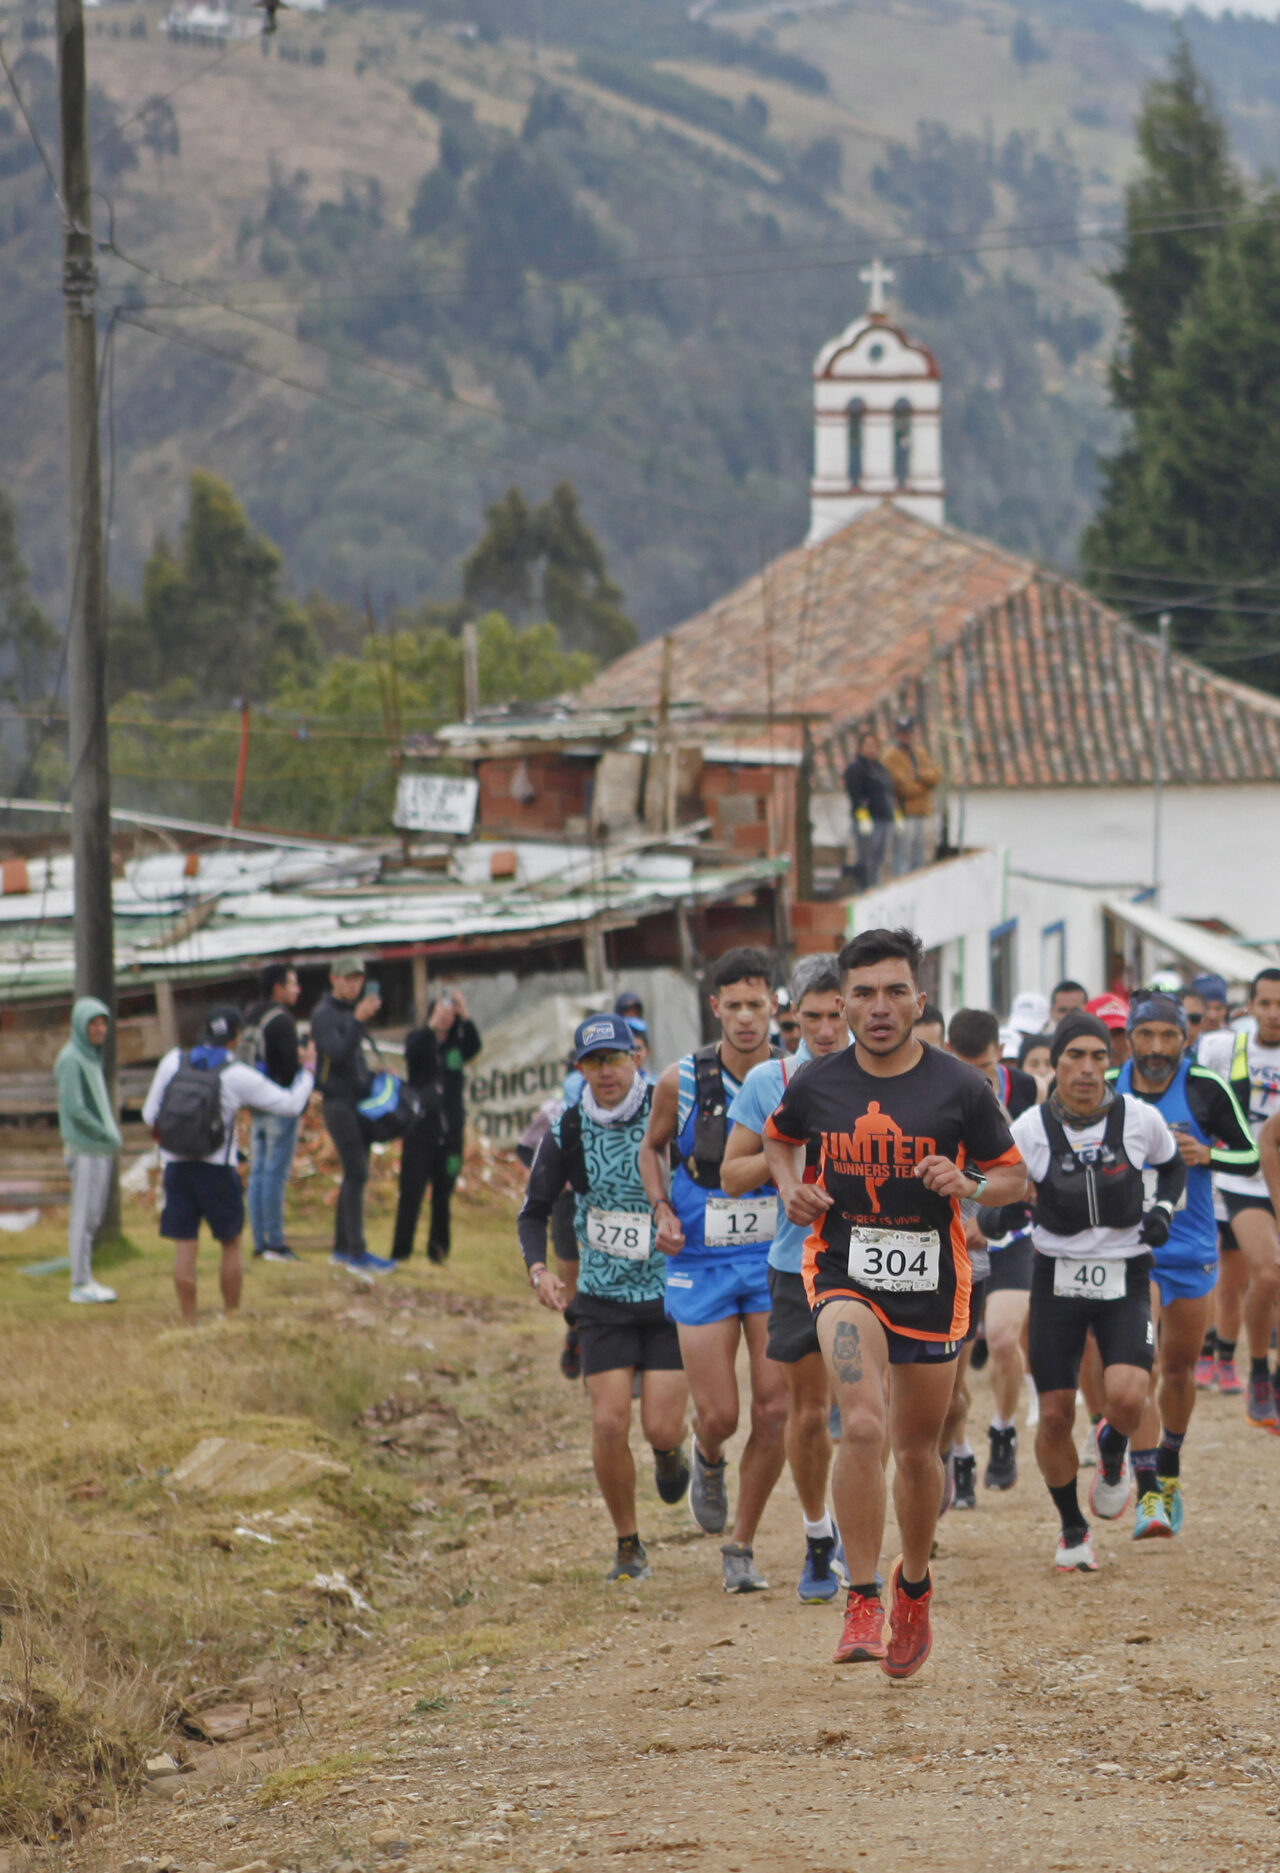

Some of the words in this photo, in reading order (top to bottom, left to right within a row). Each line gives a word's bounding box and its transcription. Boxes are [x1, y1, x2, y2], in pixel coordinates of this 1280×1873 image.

[820, 1131, 937, 1165] UNITED
[833, 1160, 890, 1178] RUNNERS
[893, 1165, 917, 1179] TEA
[727, 1213, 758, 1234] 12
[894, 1215, 921, 1225] VIVIR
[595, 1223, 639, 1248] 278
[863, 1247, 928, 1277] 304
[1073, 1264, 1106, 1287] 40
